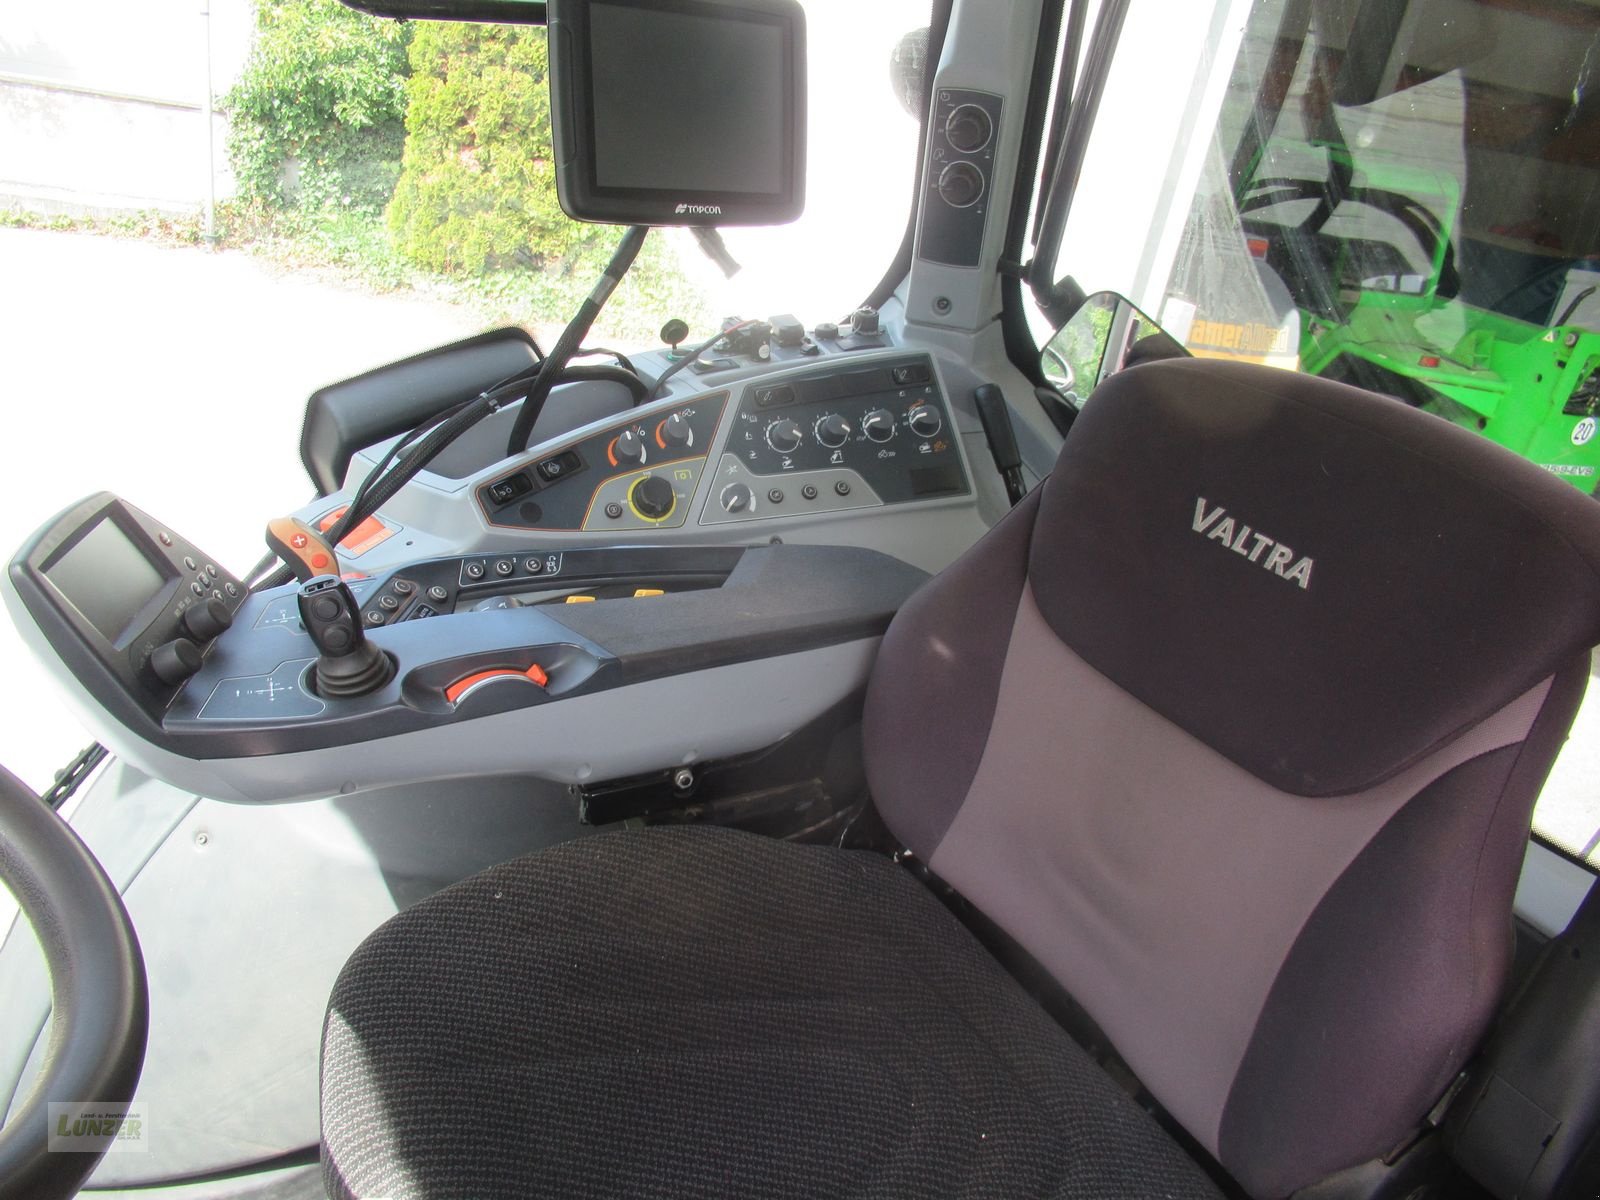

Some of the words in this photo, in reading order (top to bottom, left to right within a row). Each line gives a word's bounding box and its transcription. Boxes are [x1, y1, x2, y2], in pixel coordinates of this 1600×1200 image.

[687, 204, 721, 215] TOPCON
[1190, 319, 1289, 353] amerAllrad
[1573, 422, 1594, 441] 20
[1191, 497, 1314, 590] VALTRA
